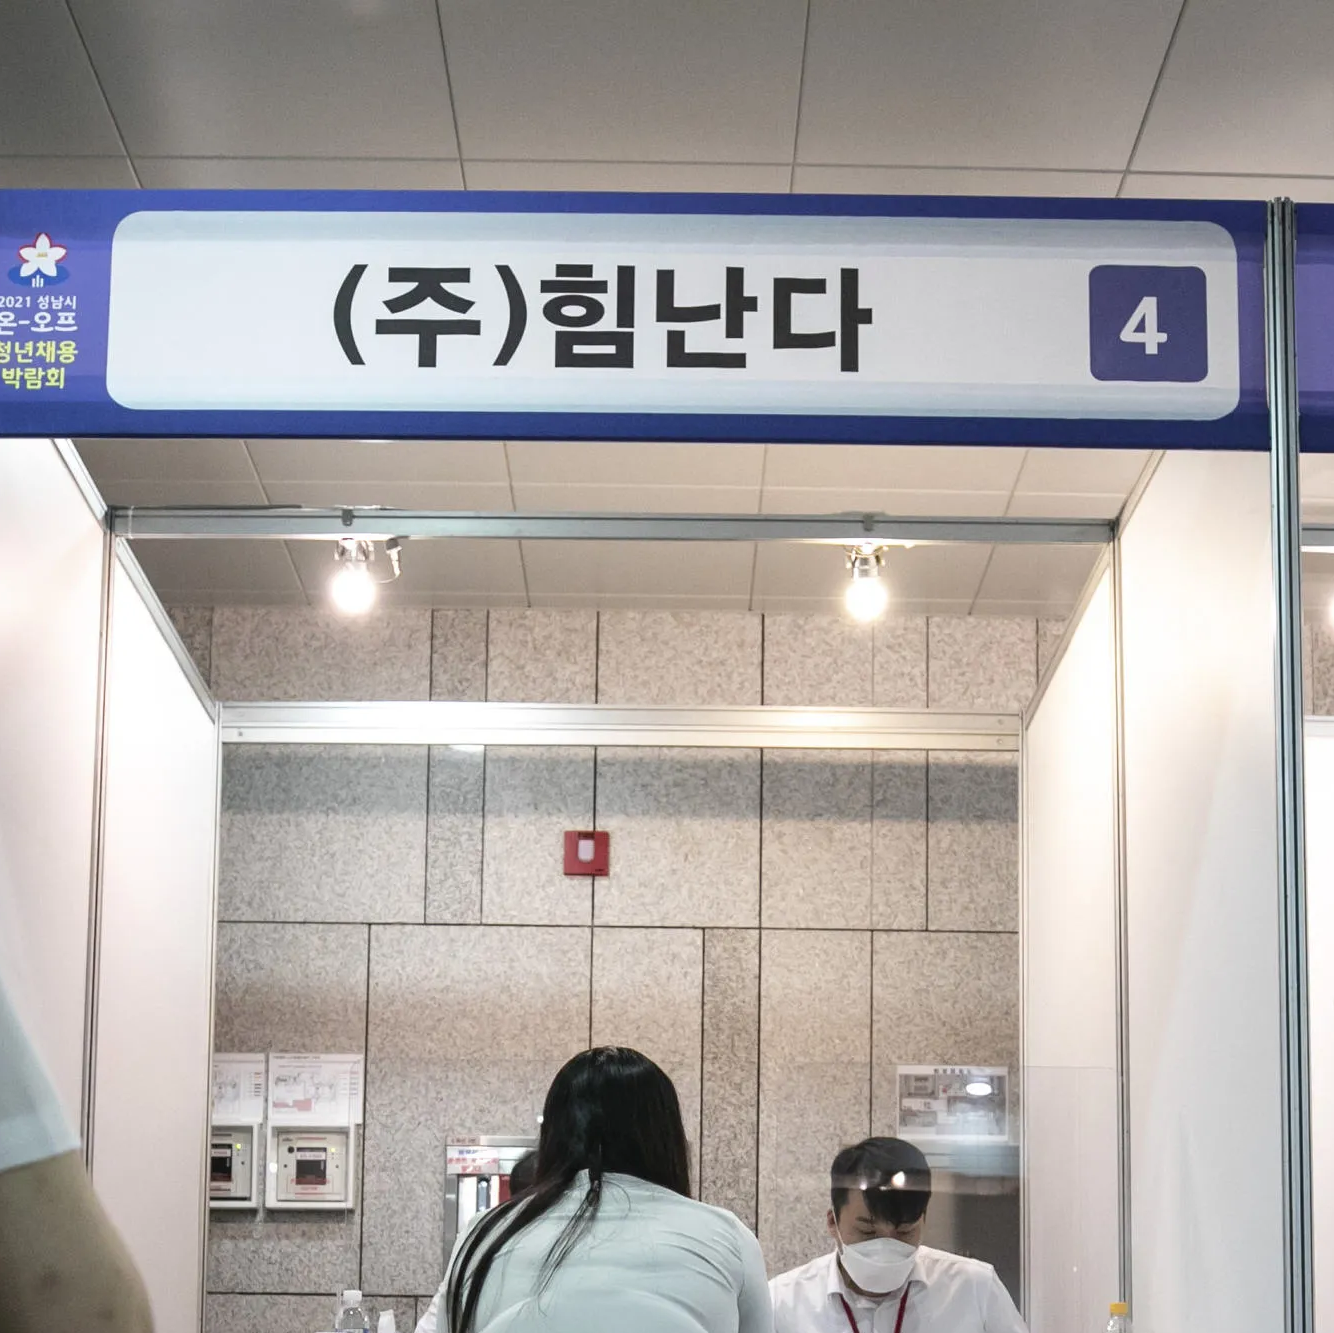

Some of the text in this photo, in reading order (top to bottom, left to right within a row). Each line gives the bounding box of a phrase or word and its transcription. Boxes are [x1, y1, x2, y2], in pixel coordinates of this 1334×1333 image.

[37, 295, 77, 310] 성남시
[333, 263, 873, 373] (주)힘난다
[1119, 296, 1168, 355] 4
[1, 366, 66, 390] 박람회
